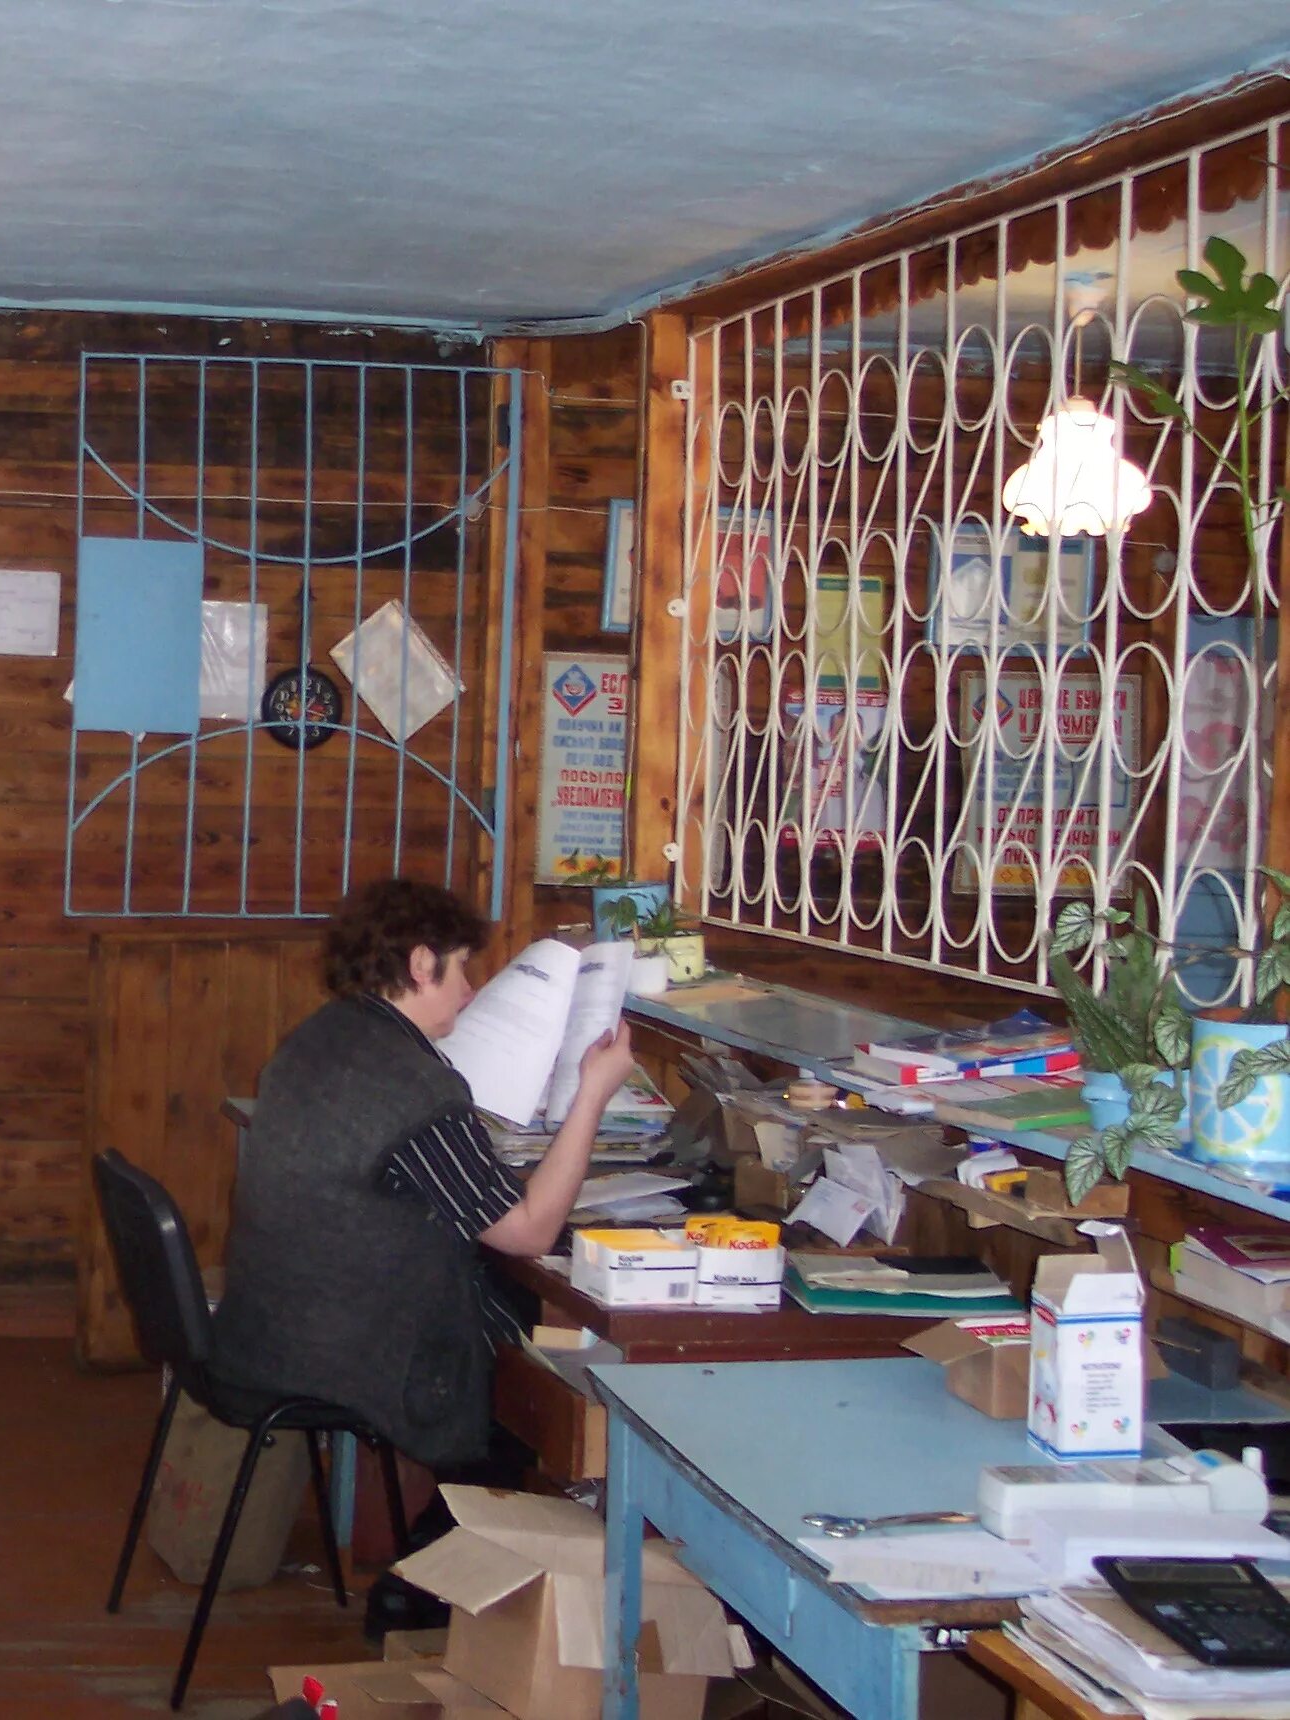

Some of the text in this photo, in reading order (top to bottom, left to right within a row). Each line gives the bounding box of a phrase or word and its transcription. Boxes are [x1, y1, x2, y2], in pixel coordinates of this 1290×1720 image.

[601, 672, 630, 694] ЕСЛ
[1075, 689, 1127, 711] БУМГИ
[728, 1239, 770, 1250] Kodak
[618, 1254, 644, 1262] Kodak
[713, 1274, 739, 1282] Kodak
